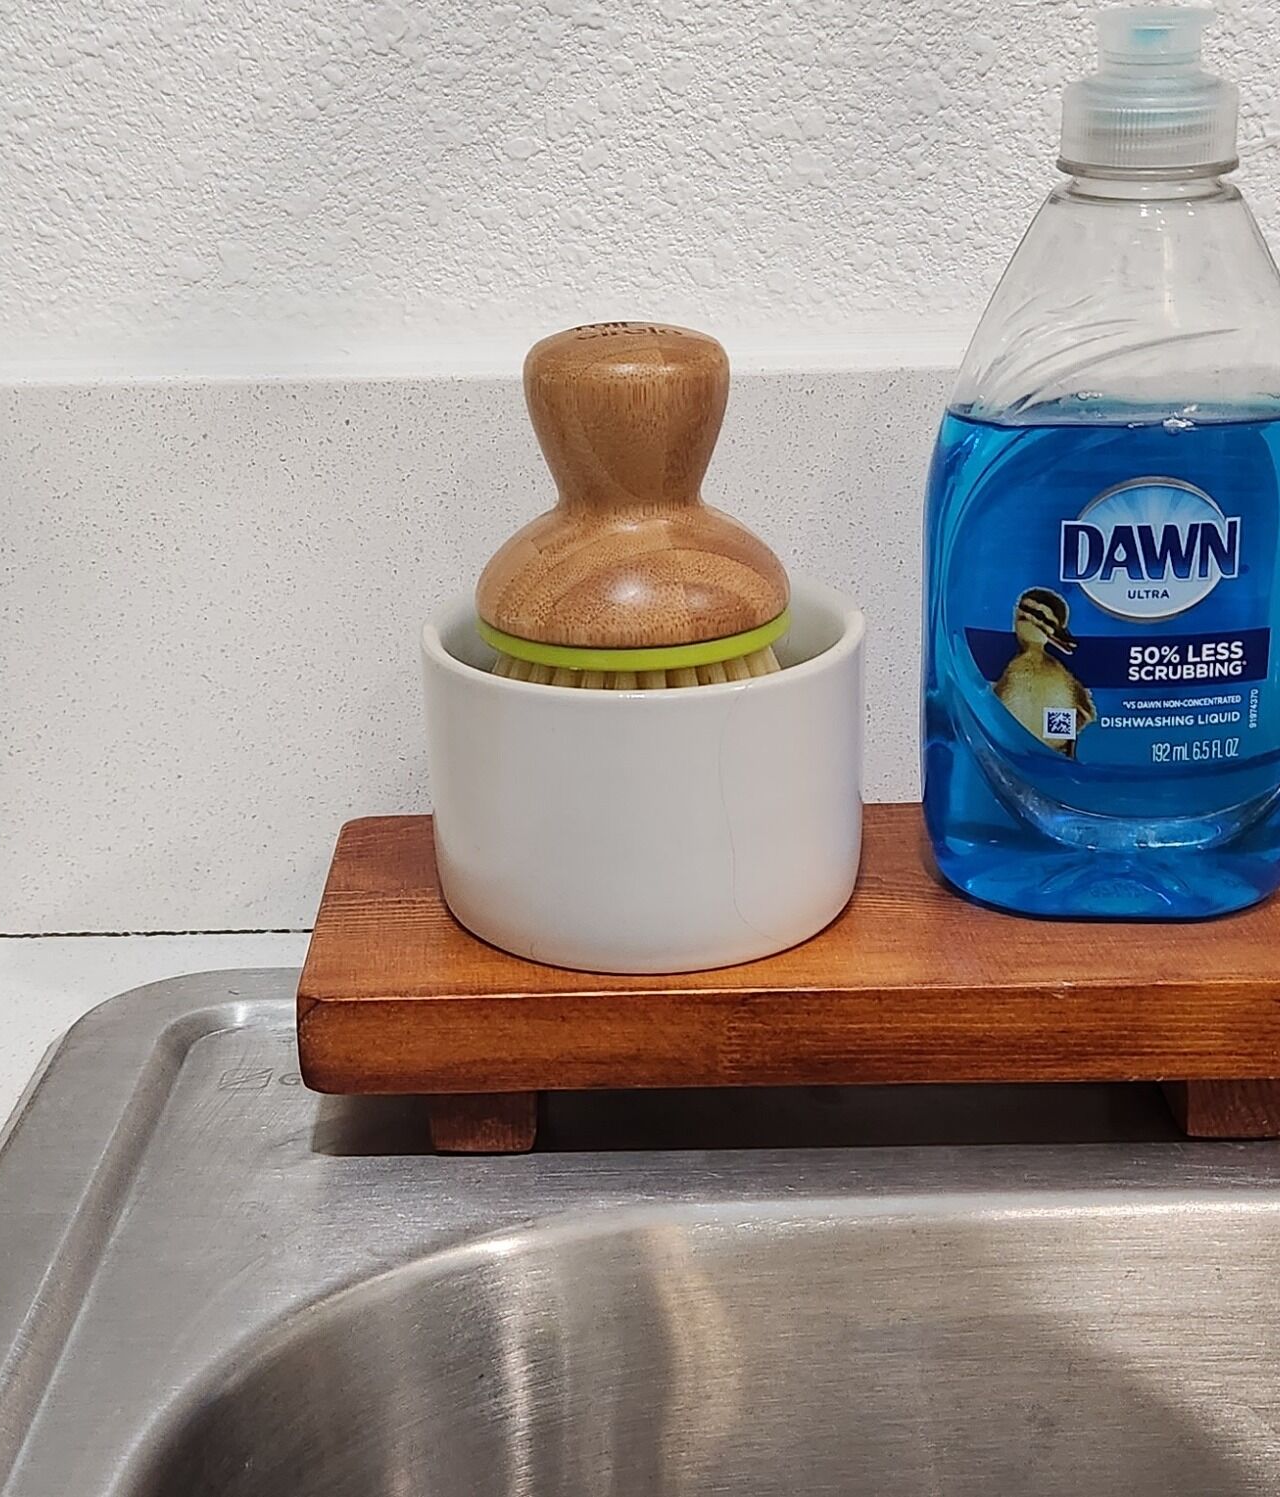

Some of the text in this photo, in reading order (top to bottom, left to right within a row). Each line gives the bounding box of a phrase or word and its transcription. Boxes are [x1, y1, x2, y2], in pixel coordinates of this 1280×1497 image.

[1061, 517, 1241, 582] DAWN
[1127, 589, 1170, 600] ULTRA
[1128, 641, 1244, 665] 50% LESS
[1137, 700, 1162, 709] DAWN
[1162, 695, 1241, 708] NON-CONCENTRATED
[1100, 711, 1241, 728] DISHWASHING LIQUID
[1151, 738, 1240, 763] 192 mL 6.5 FL OZ
